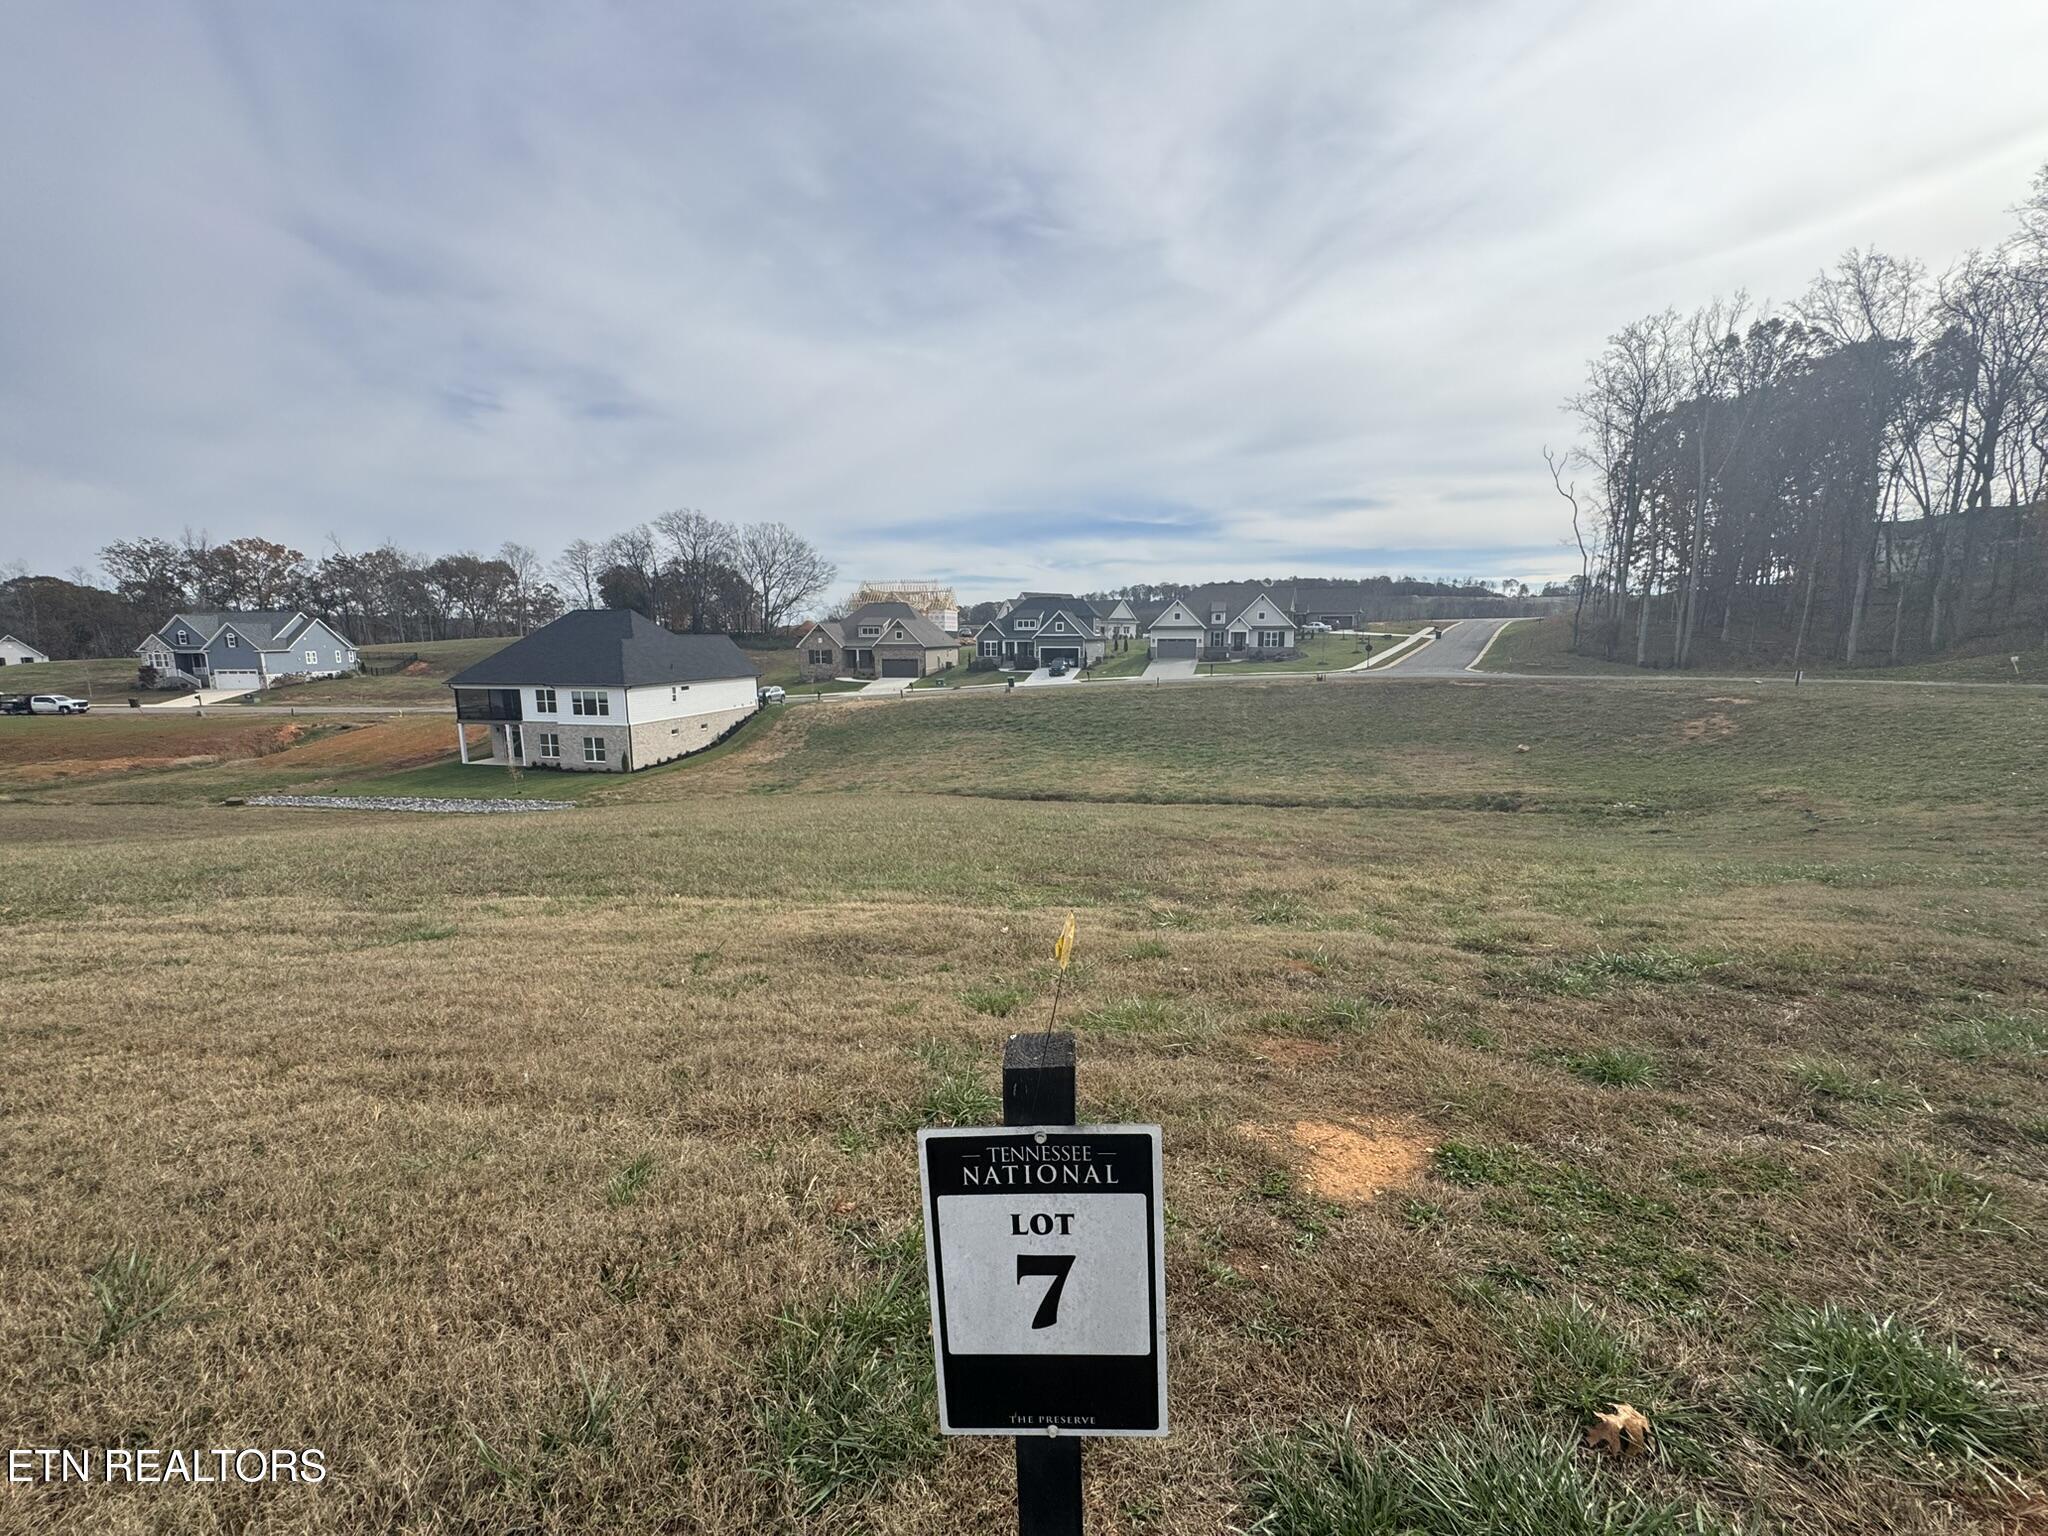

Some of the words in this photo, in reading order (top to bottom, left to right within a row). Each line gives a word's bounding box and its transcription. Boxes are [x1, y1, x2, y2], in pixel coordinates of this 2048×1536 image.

[986, 1145, 1092, 1162] TENNESSEE
[963, 1164, 1119, 1186] NATIONAL
[1010, 1213, 1075, 1236] LOT
[1016, 1254, 1077, 1330] 7
[1009, 1414, 1034, 1425] THE
[1038, 1415, 1096, 1425] PRESERVE
